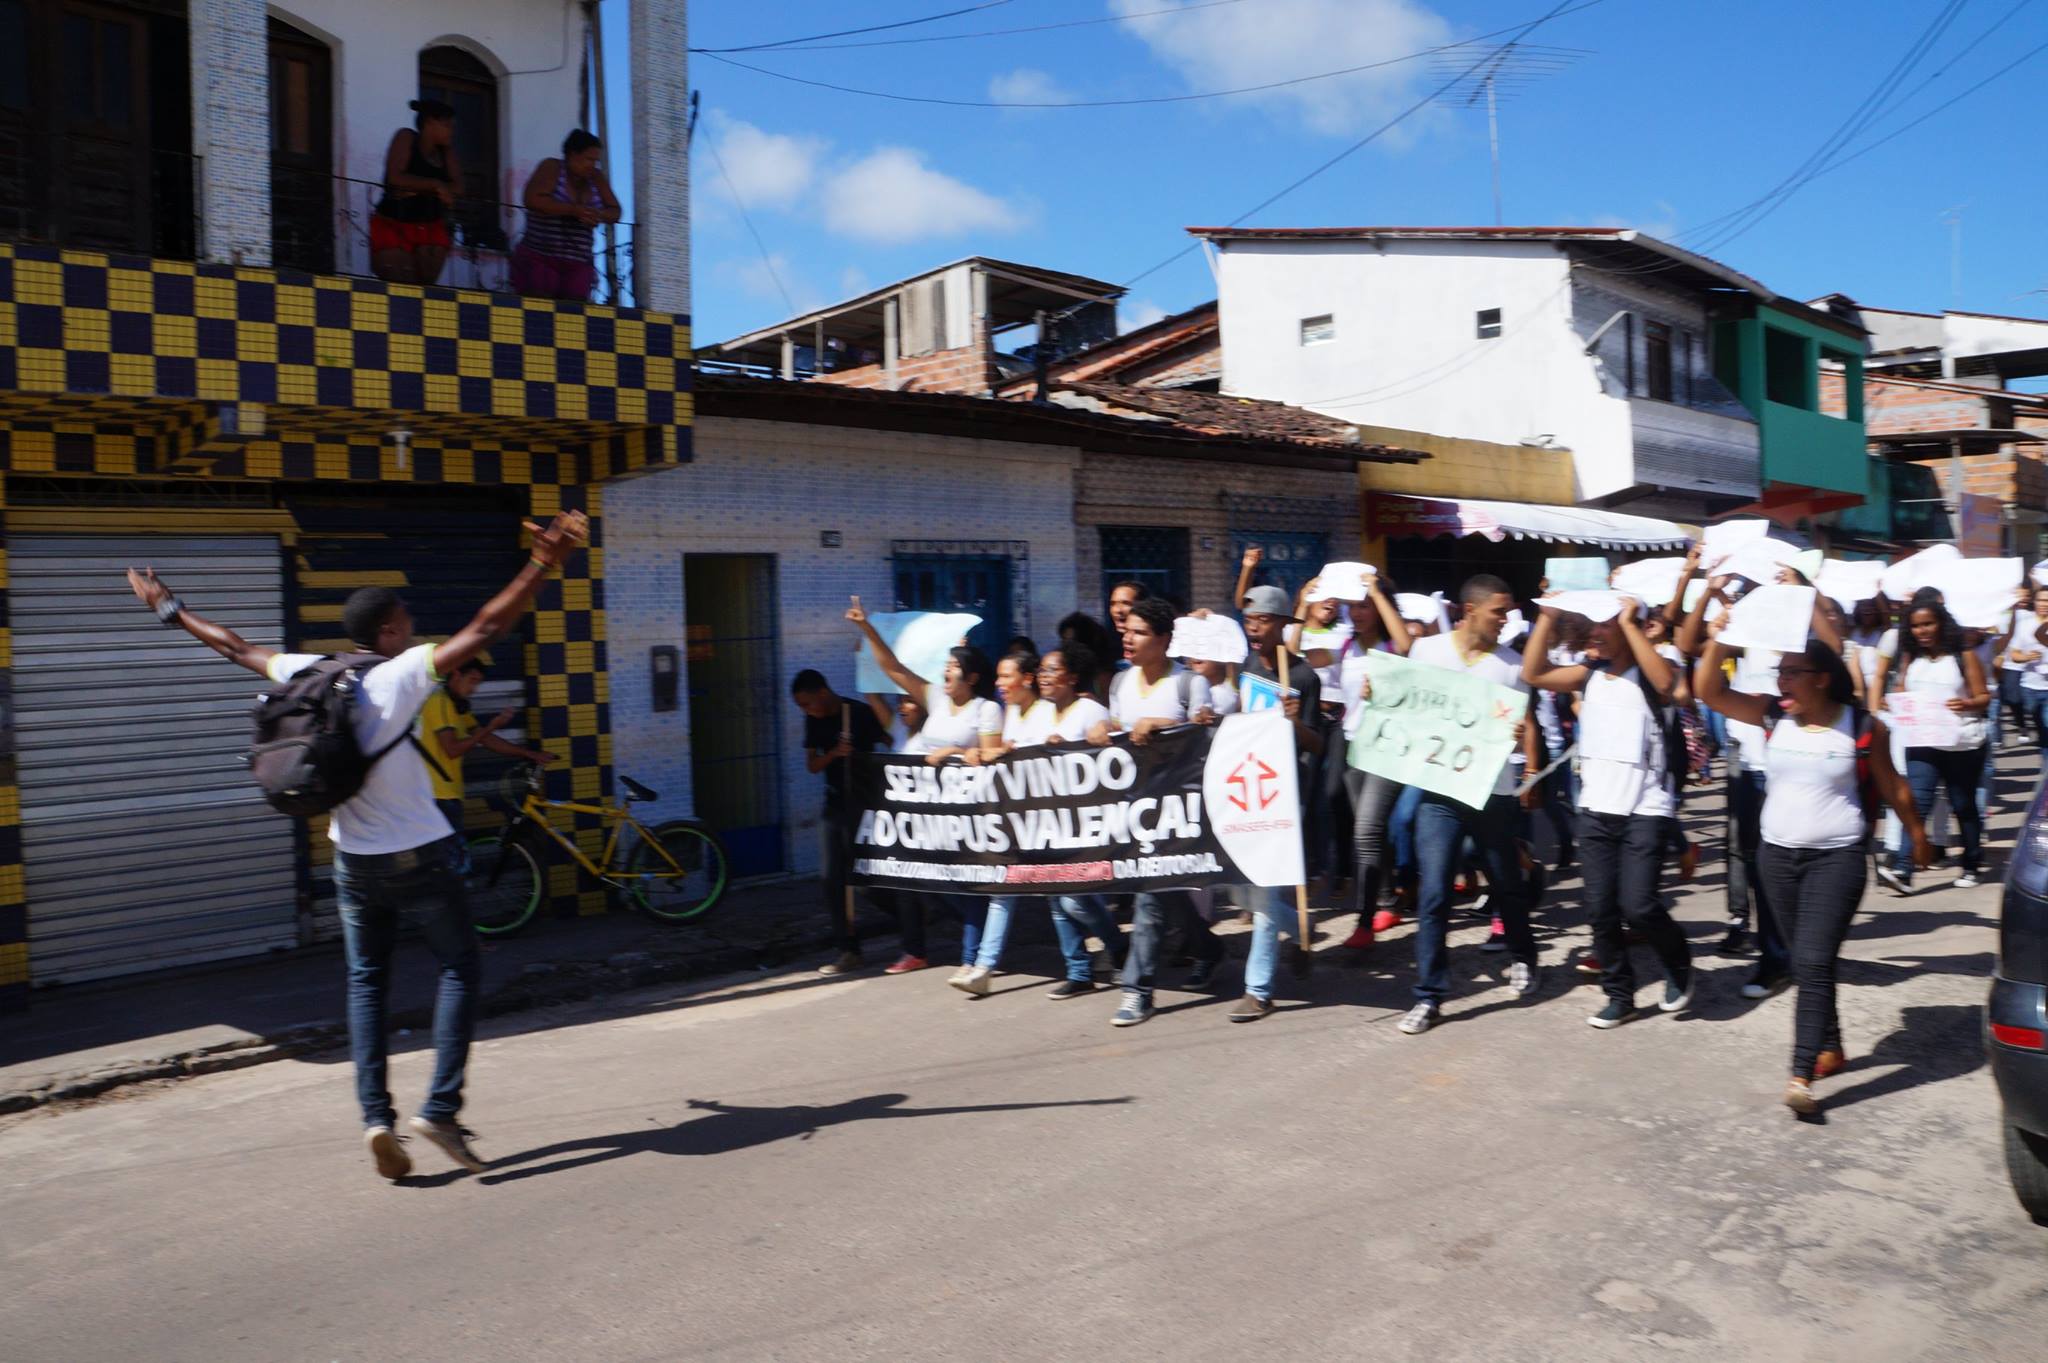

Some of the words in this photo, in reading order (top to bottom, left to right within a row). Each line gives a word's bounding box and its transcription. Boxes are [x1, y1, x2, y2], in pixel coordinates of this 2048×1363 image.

[884, 764, 941, 804] SEJA
[995, 746, 1138, 802] VINDO
[855, 809, 898, 848] AO
[894, 810, 1011, 853] CAMPUS
[1006, 791, 1202, 855] VALENÇA!
